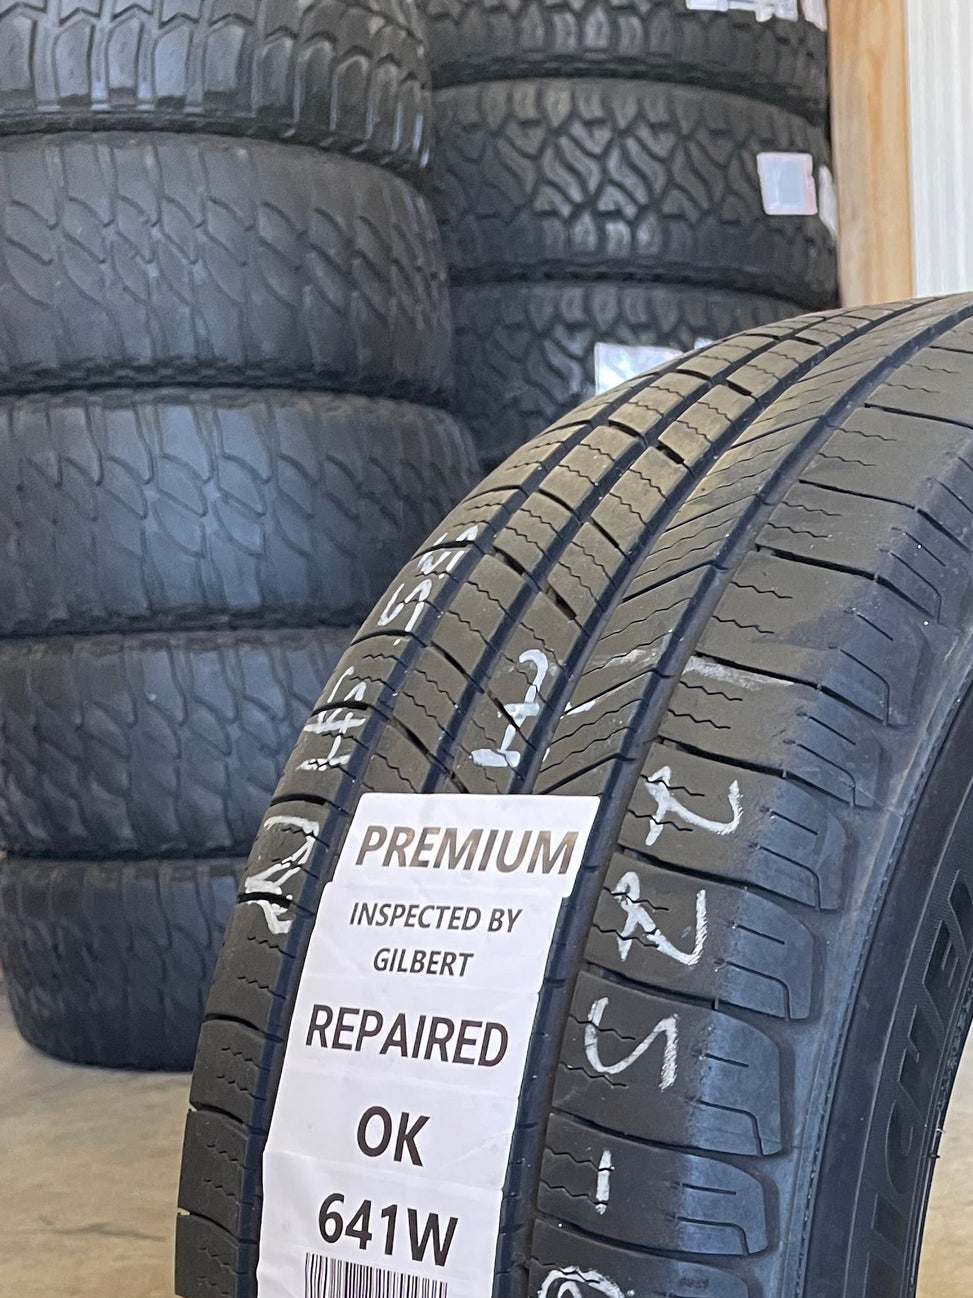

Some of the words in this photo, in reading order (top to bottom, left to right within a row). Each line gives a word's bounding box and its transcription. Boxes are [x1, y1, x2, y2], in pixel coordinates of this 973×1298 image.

[355, 826, 579, 875] PREMIUM
[349, 902, 481, 932] INSPECTED
[487, 908, 523, 935] BY
[373, 948, 474, 977] GILBERT
[305, 1004, 509, 1067] REPAIRED
[356, 1106, 430, 1166] OK
[318, 1193, 458, 1267] 641W
